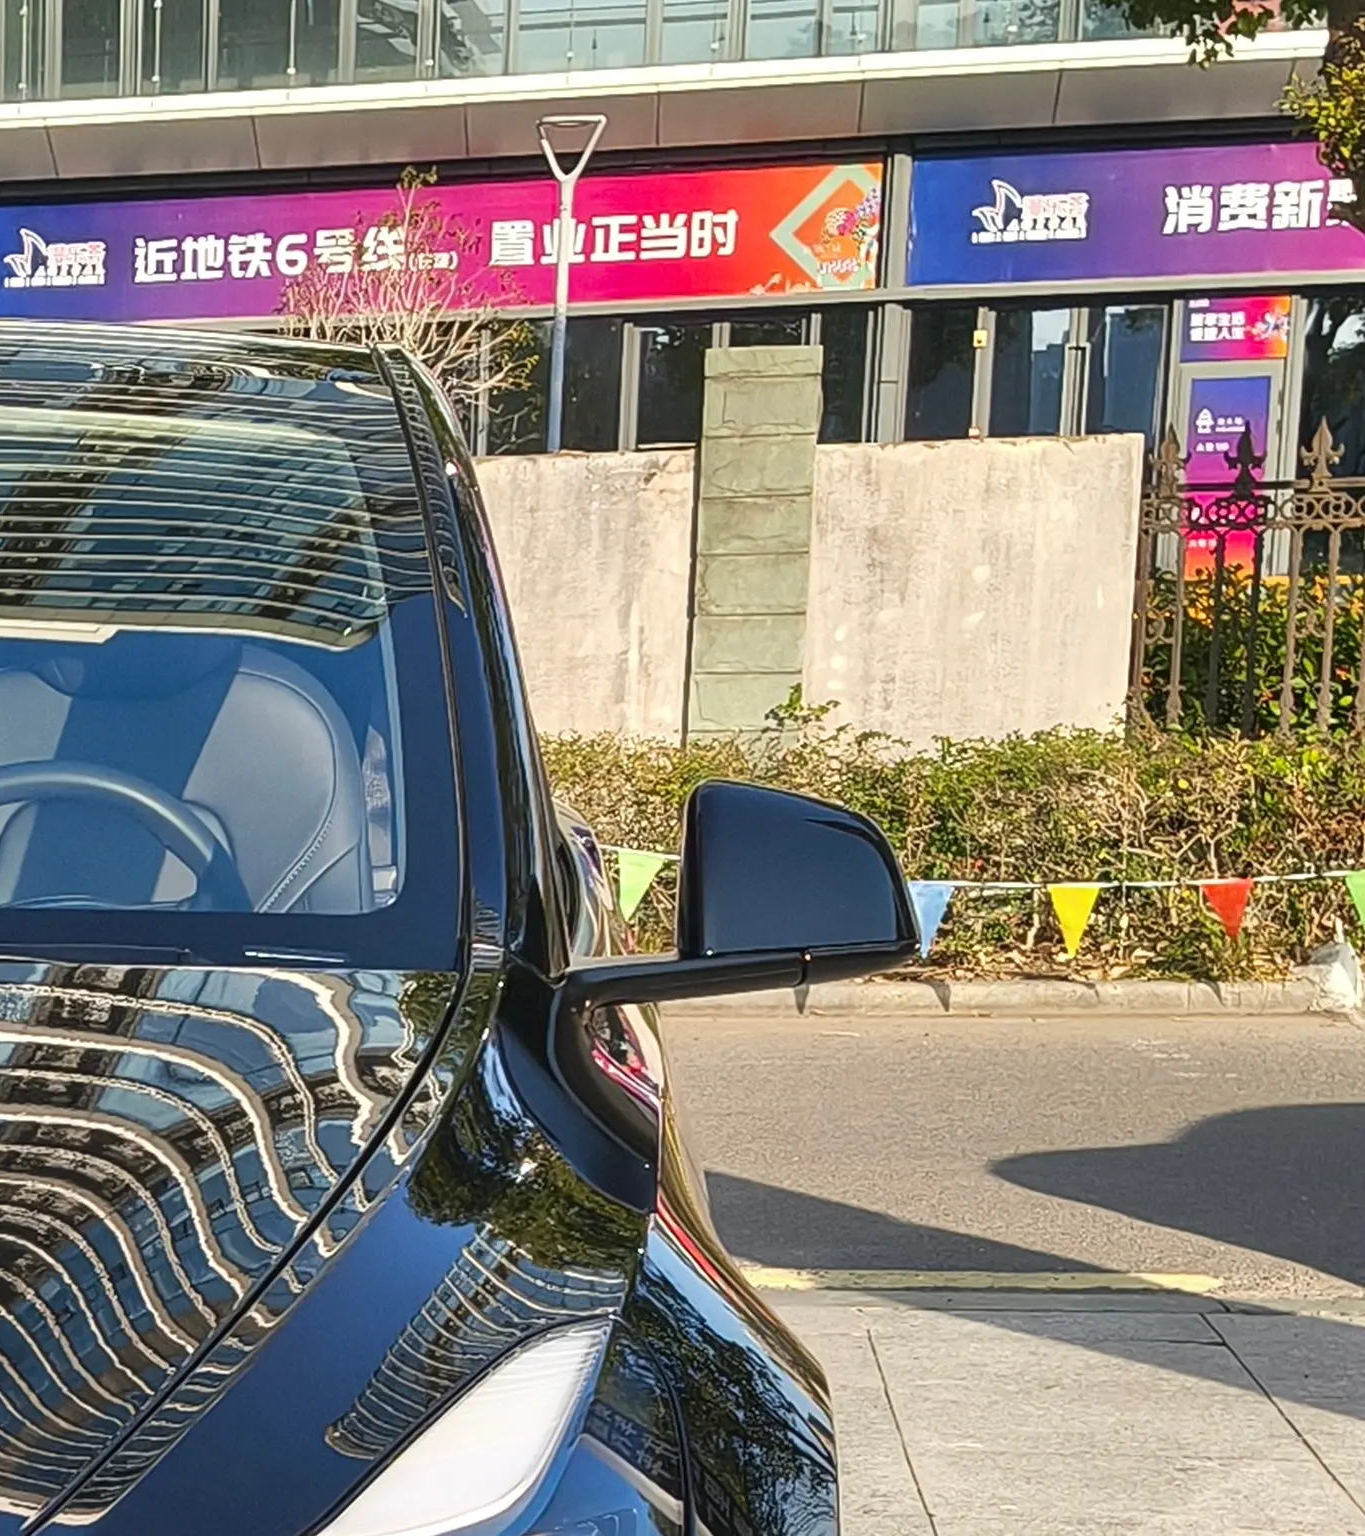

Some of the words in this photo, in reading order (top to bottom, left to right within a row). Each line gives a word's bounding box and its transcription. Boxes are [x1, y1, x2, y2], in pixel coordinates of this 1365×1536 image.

[490, 209, 740, 266] 置业正当时
